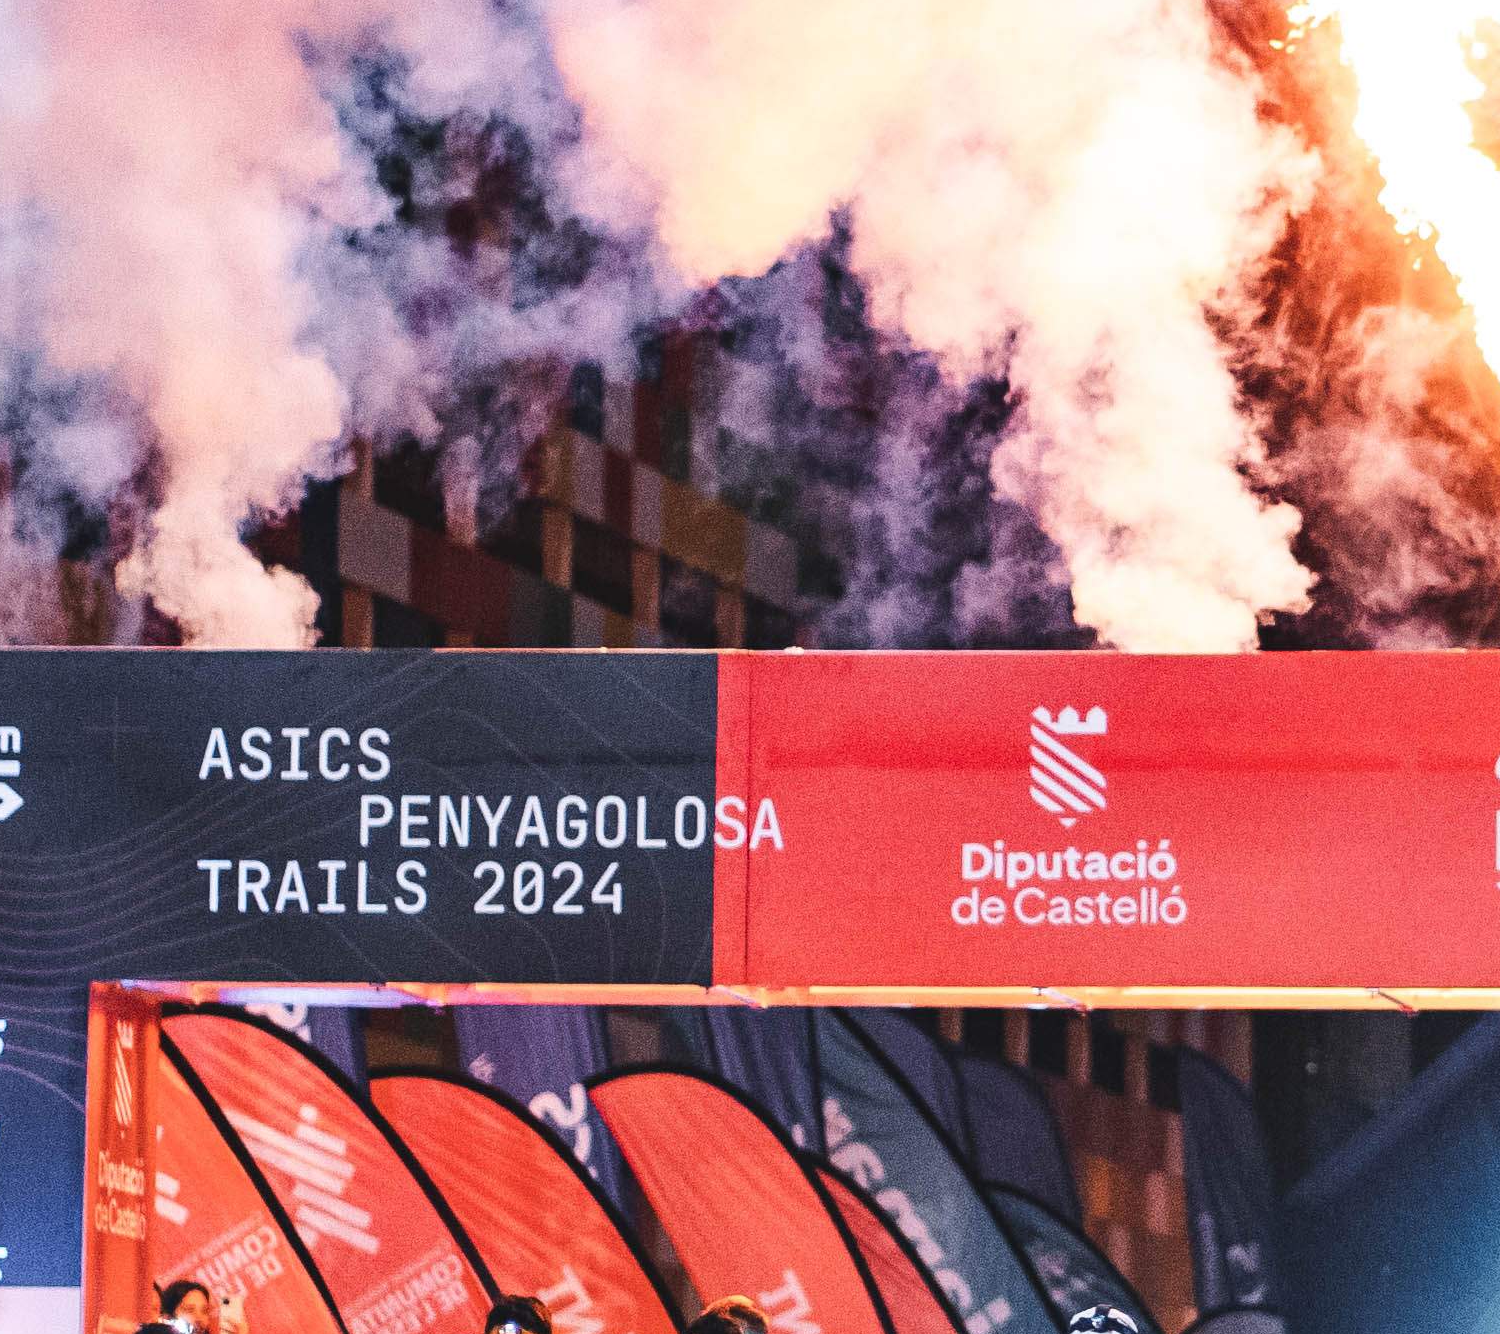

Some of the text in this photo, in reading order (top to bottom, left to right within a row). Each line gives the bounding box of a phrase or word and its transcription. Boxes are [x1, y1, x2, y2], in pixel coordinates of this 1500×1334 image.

[199, 727, 391, 781] ASICS
[360, 794, 785, 850] PENYAGOLOSA
[197, 860, 622, 914] TRAILS 2024
[961, 839, 1177, 884] Diputació
[951, 883, 1188, 926] de Castelló
